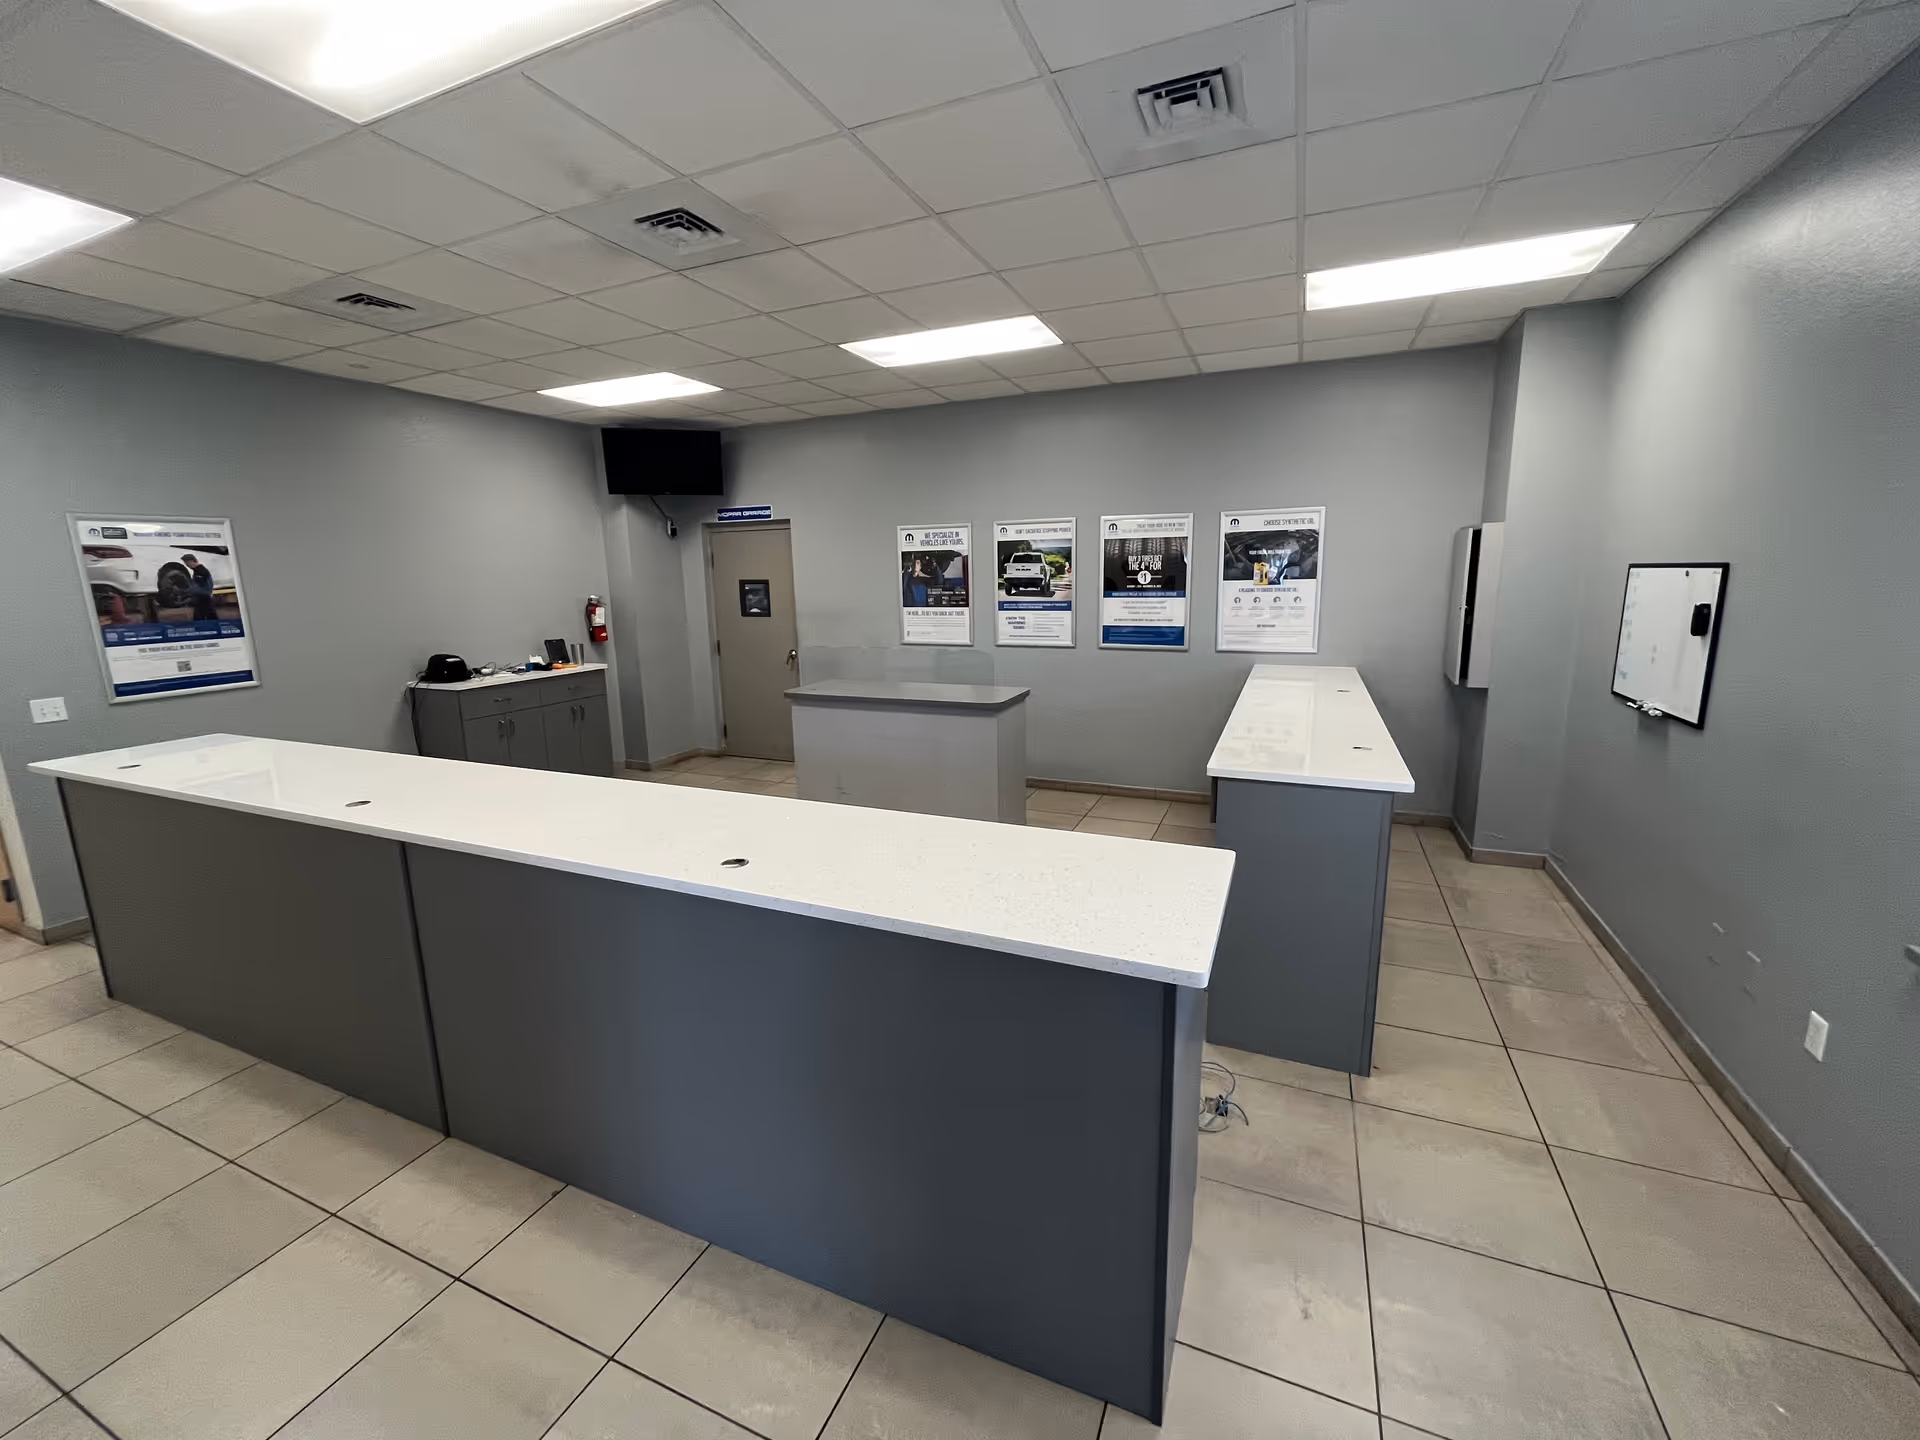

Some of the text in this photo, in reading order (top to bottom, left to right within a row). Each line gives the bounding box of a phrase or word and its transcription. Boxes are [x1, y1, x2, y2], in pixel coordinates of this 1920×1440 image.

[1128, 561, 1140, 570] THE
[1150, 561, 1162, 570] FOR
[1140, 572, 1147, 582] $1
